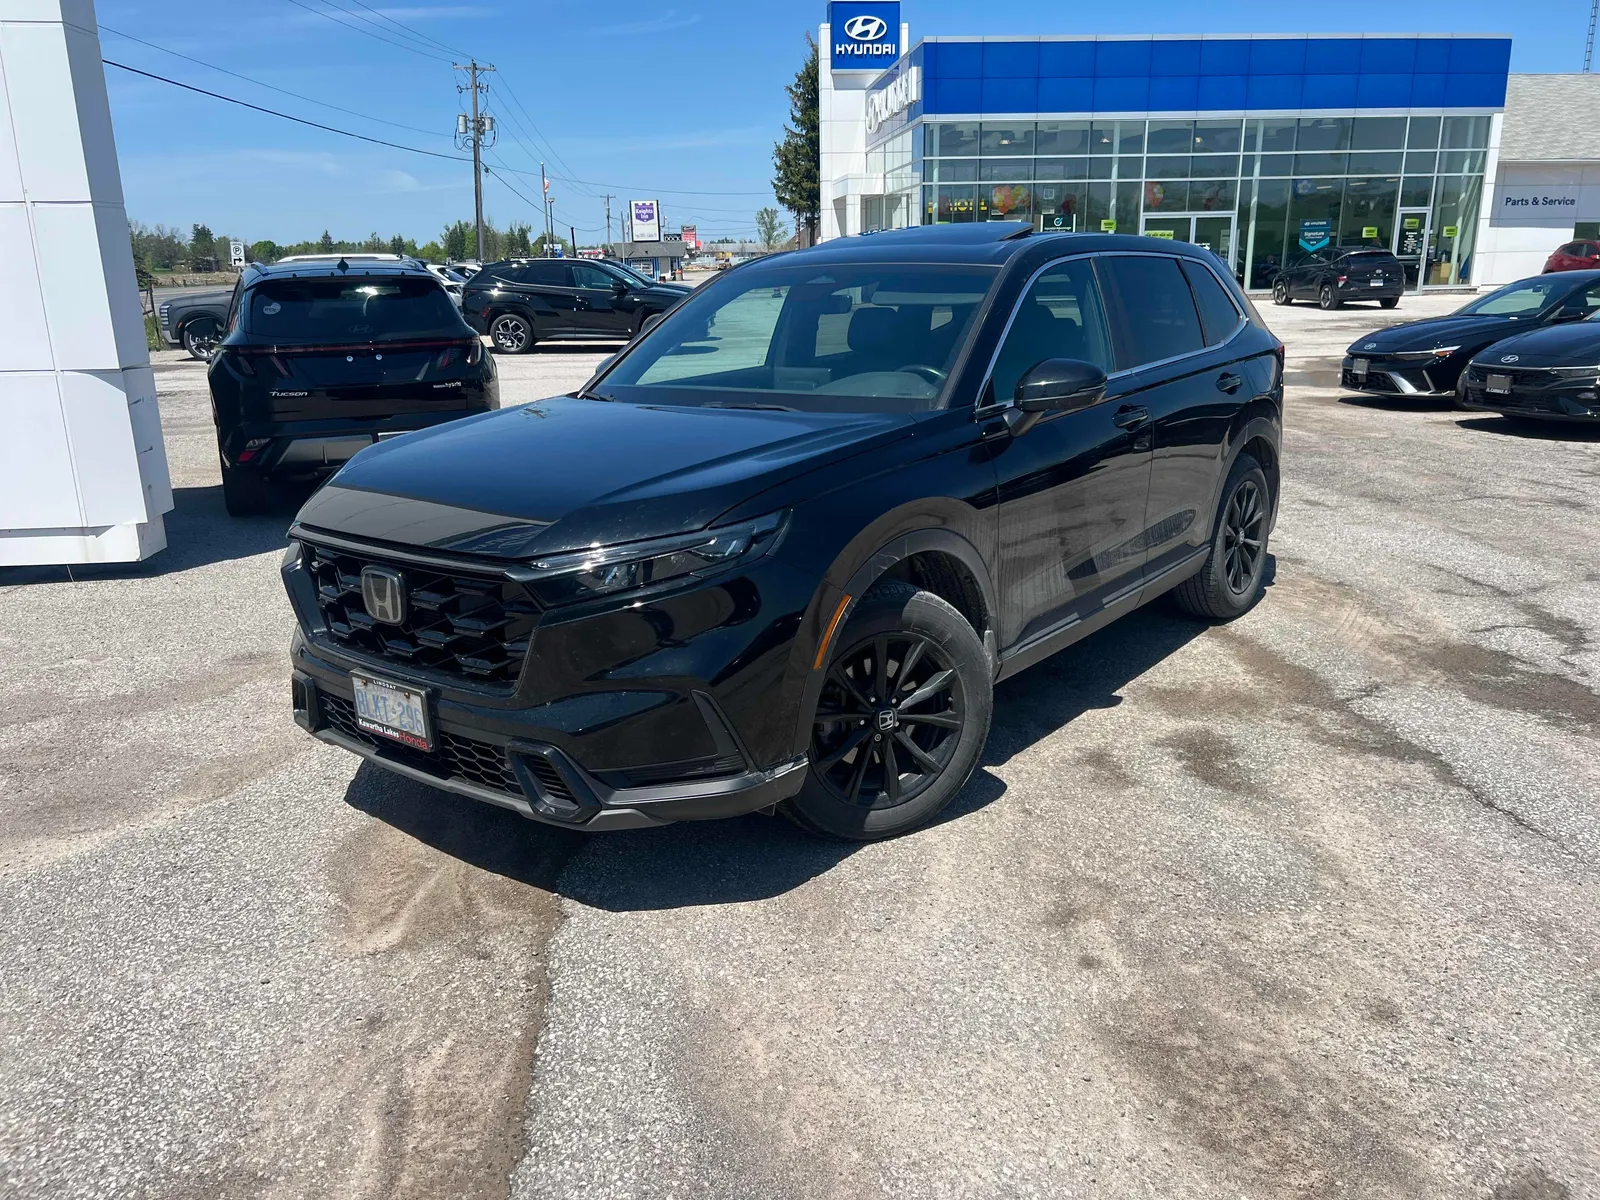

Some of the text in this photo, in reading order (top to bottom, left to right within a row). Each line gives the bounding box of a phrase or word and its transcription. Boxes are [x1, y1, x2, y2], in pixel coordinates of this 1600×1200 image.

[836, 43, 896, 55] HYUNDAI
[1505, 196, 1576, 206] Parts & Service
[635, 207, 654, 215] Knights
[372, 679, 397, 690] LINDSAY
[358, 718, 428, 750] Kawartha Lakes Honda
